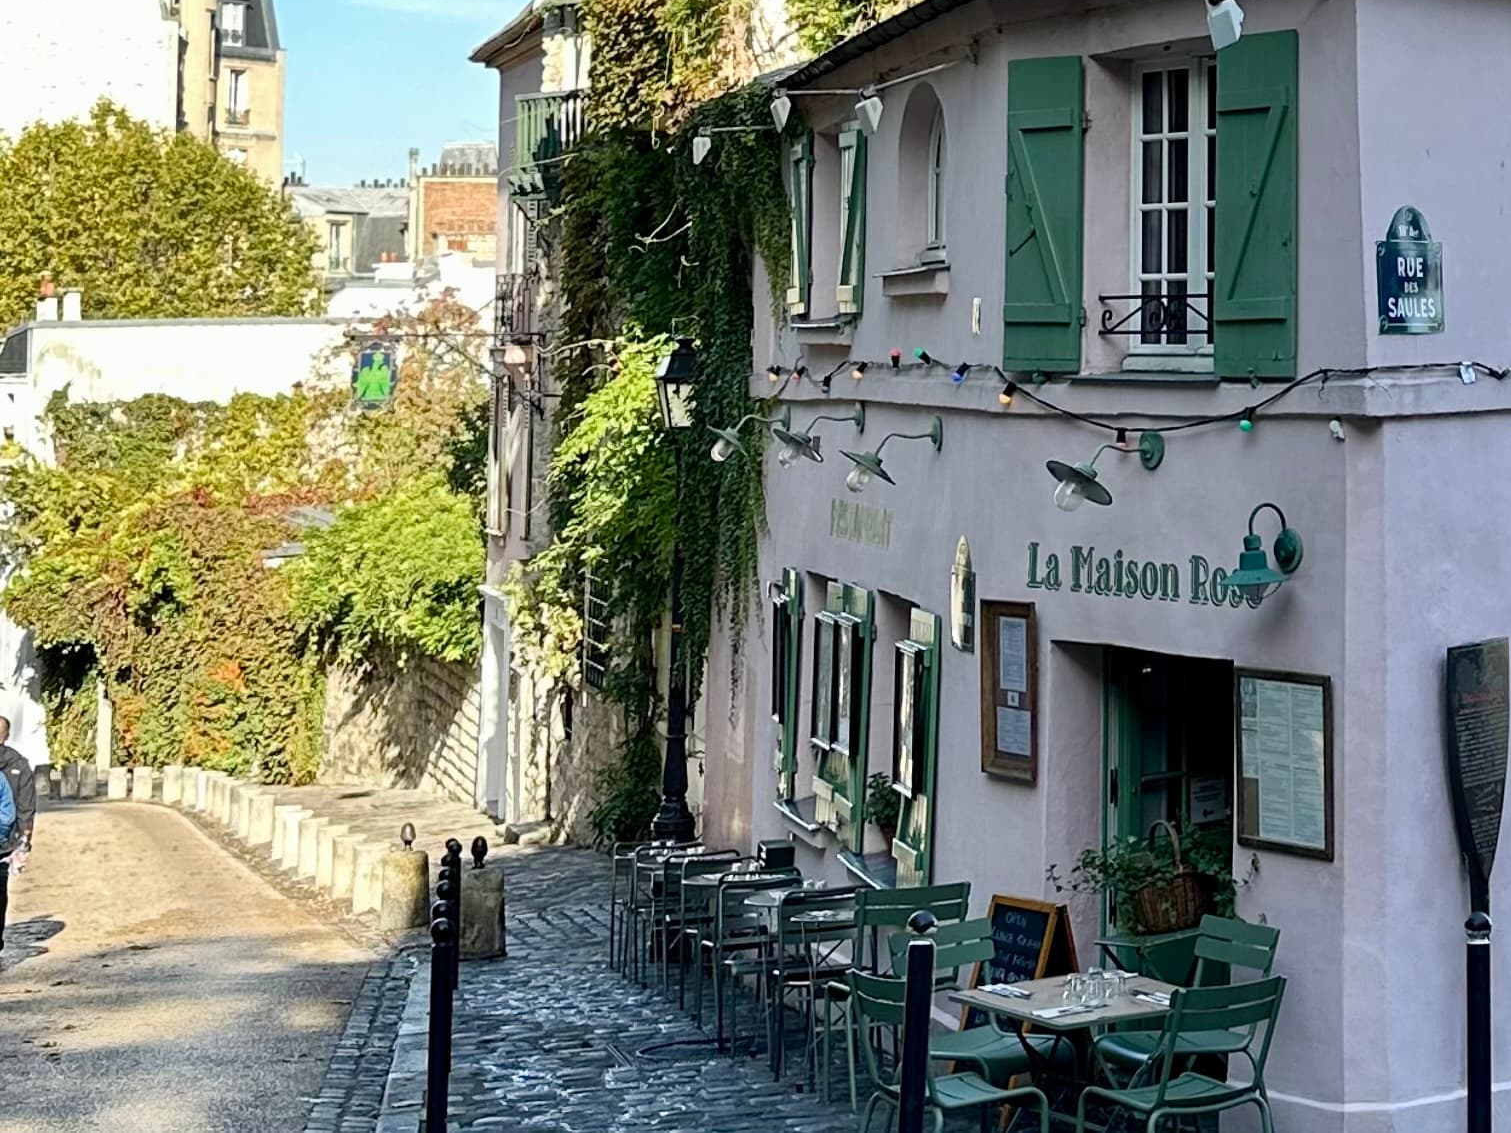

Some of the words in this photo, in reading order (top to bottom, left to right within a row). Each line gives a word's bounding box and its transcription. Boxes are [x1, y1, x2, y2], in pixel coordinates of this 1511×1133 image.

[1397, 257, 1424, 278] RUE
[1404, 281, 1419, 294] DES
[1388, 297, 1436, 318] SAULES
[1026, 541, 1062, 591] La
[1070, 545, 1181, 601] Maison
